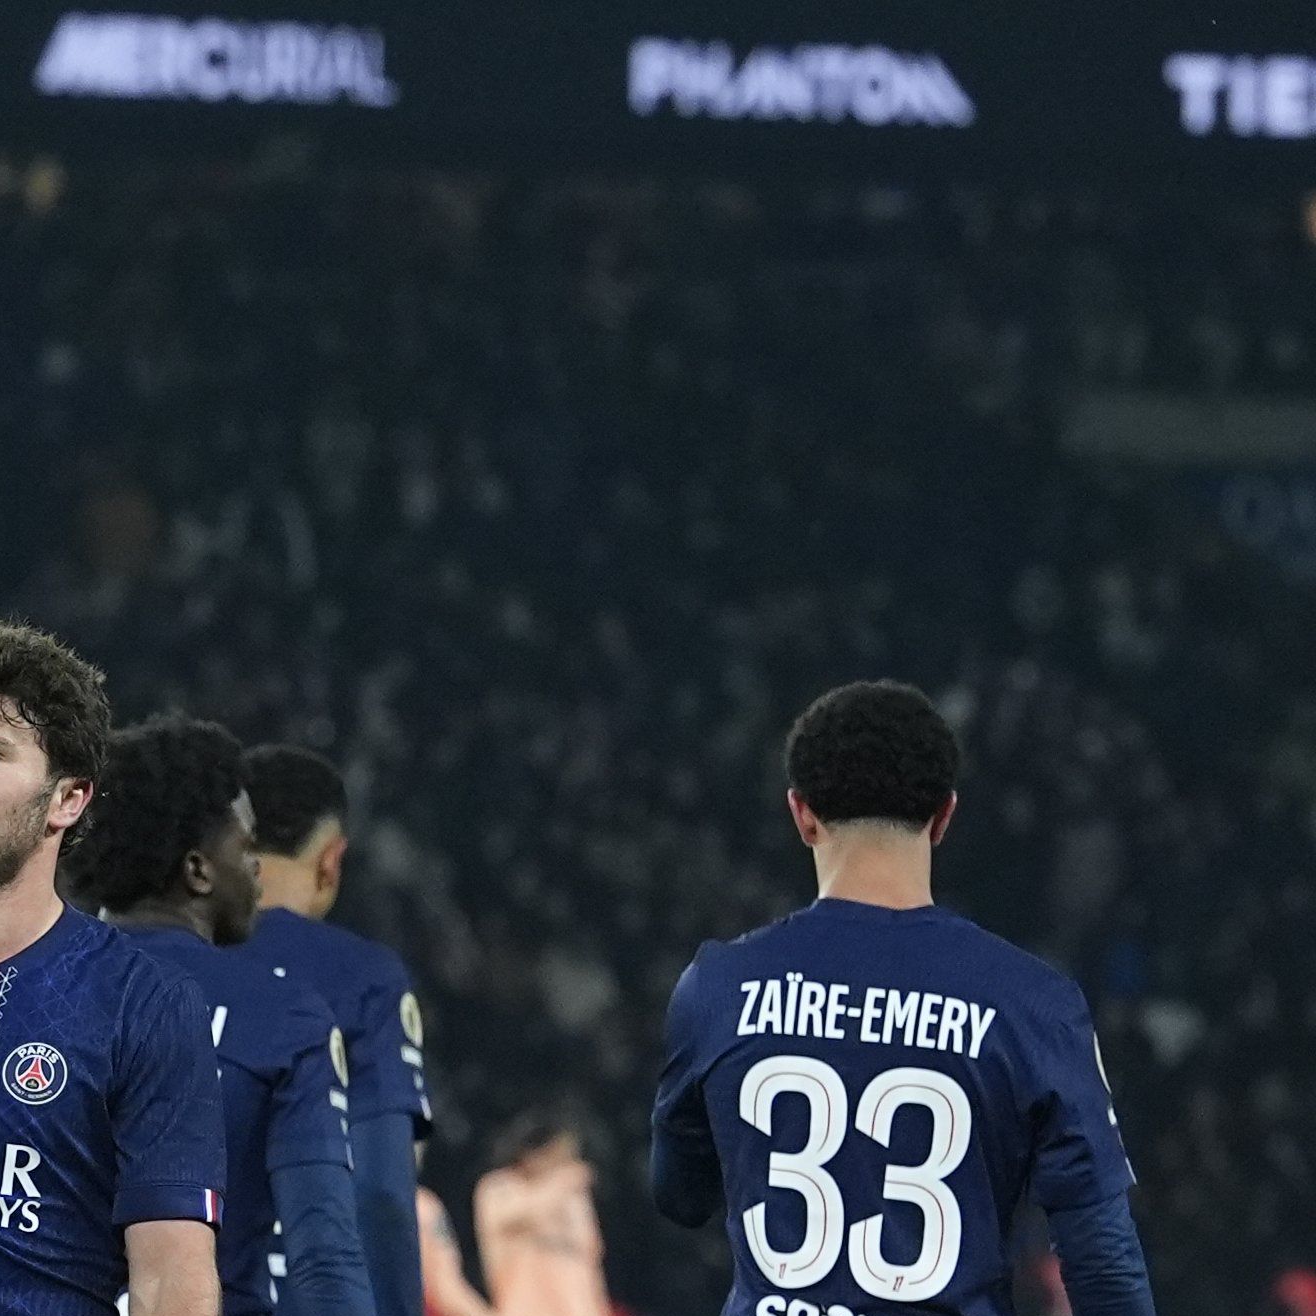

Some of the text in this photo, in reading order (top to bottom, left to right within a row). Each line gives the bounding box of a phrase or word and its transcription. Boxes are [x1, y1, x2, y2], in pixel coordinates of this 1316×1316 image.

[35, 14, 390, 104] MERCURIAL
[628, 39, 974, 124] PHANTOM
[17, 1046, 59, 1064] PARIS
[736, 971, 997, 1060] ZAÏRE-EMERY
[739, 1055, 973, 1302] 33
